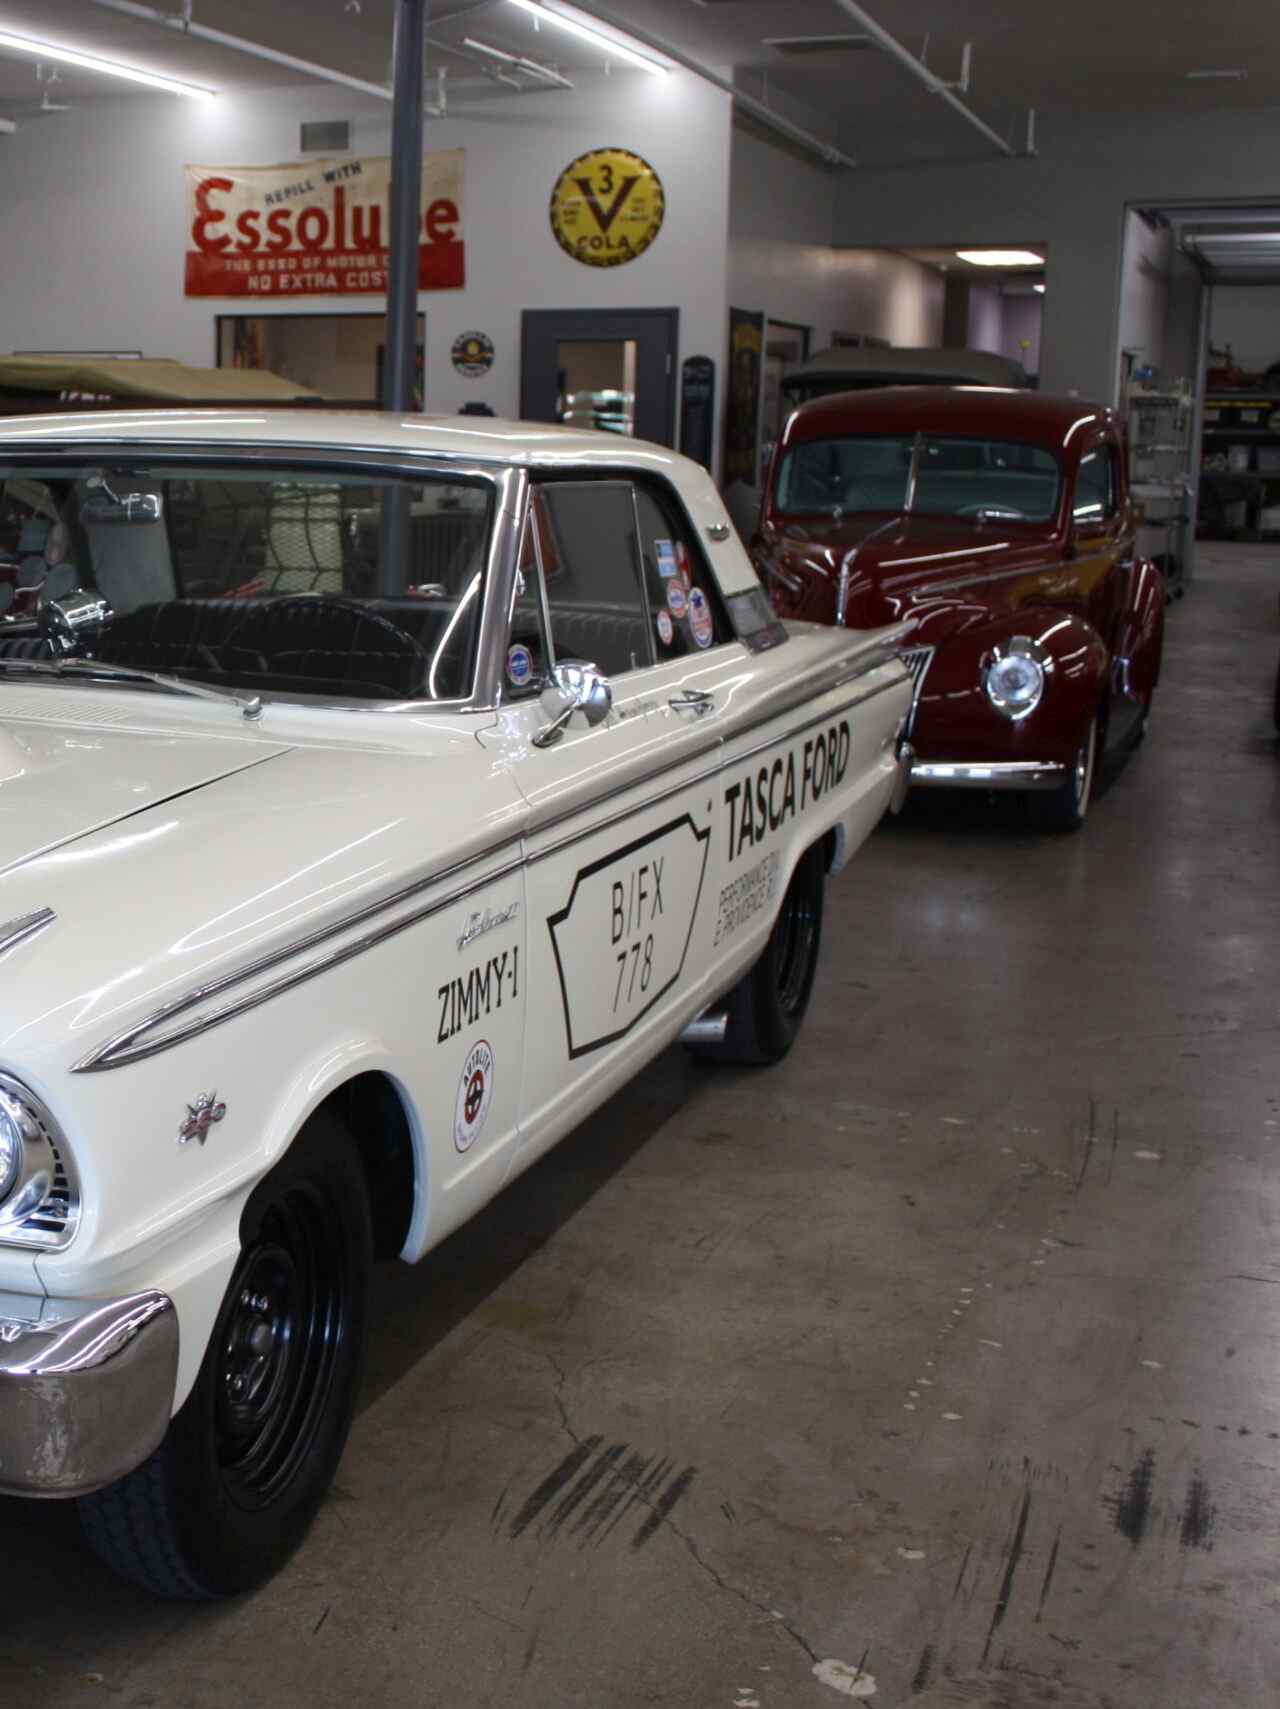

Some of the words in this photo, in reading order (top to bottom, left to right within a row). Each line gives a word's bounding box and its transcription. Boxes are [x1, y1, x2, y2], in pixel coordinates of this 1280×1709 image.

[265, 176, 315, 206] REFILL
[322, 160, 364, 184] WITH
[571, 175, 642, 233] V
[598, 164, 614, 194] 3
[192, 177, 460, 252] Essolue
[248, 274, 271, 290] NO
[280, 271, 337, 289] EXTRA
[725, 751, 796, 862] TASCA
[801, 720, 850, 811] FORD
[612, 856, 664, 946] B/FX
[613, 933, 653, 1013] 778
